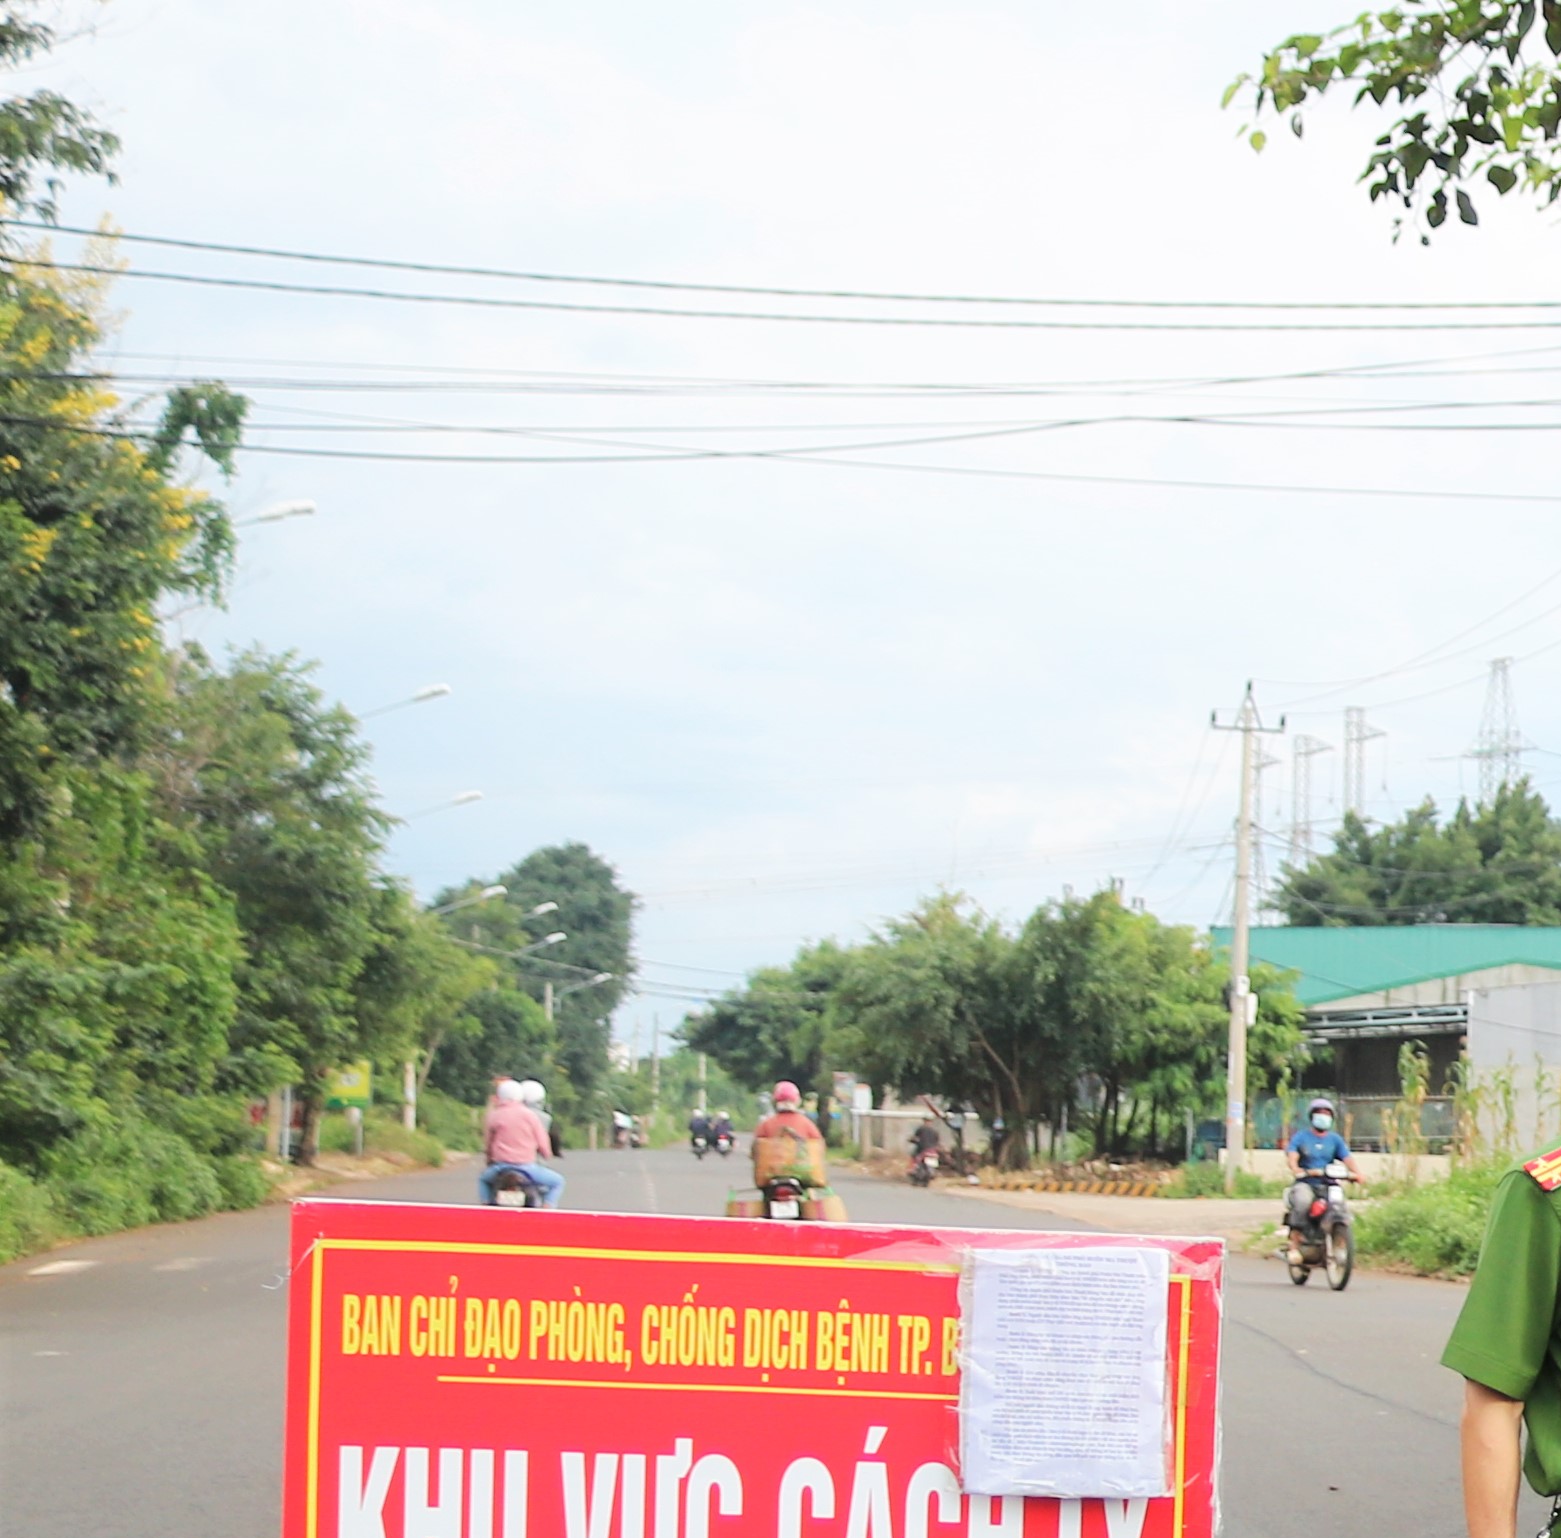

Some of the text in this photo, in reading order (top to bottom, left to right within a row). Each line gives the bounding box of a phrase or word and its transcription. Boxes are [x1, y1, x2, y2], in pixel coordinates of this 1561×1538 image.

[342, 1294, 401, 1356] BAN
[409, 1275, 458, 1357] CHỈ
[464, 1297, 521, 1373] ĐẠO
[529, 1285, 632, 1372] PHÒNG,
[641, 1283, 736, 1367] CHỐNG
[743, 1308, 809, 1382] DỊCH
[816, 1298, 890, 1386] BỆNH
[898, 1315, 933, 1376] TP.
